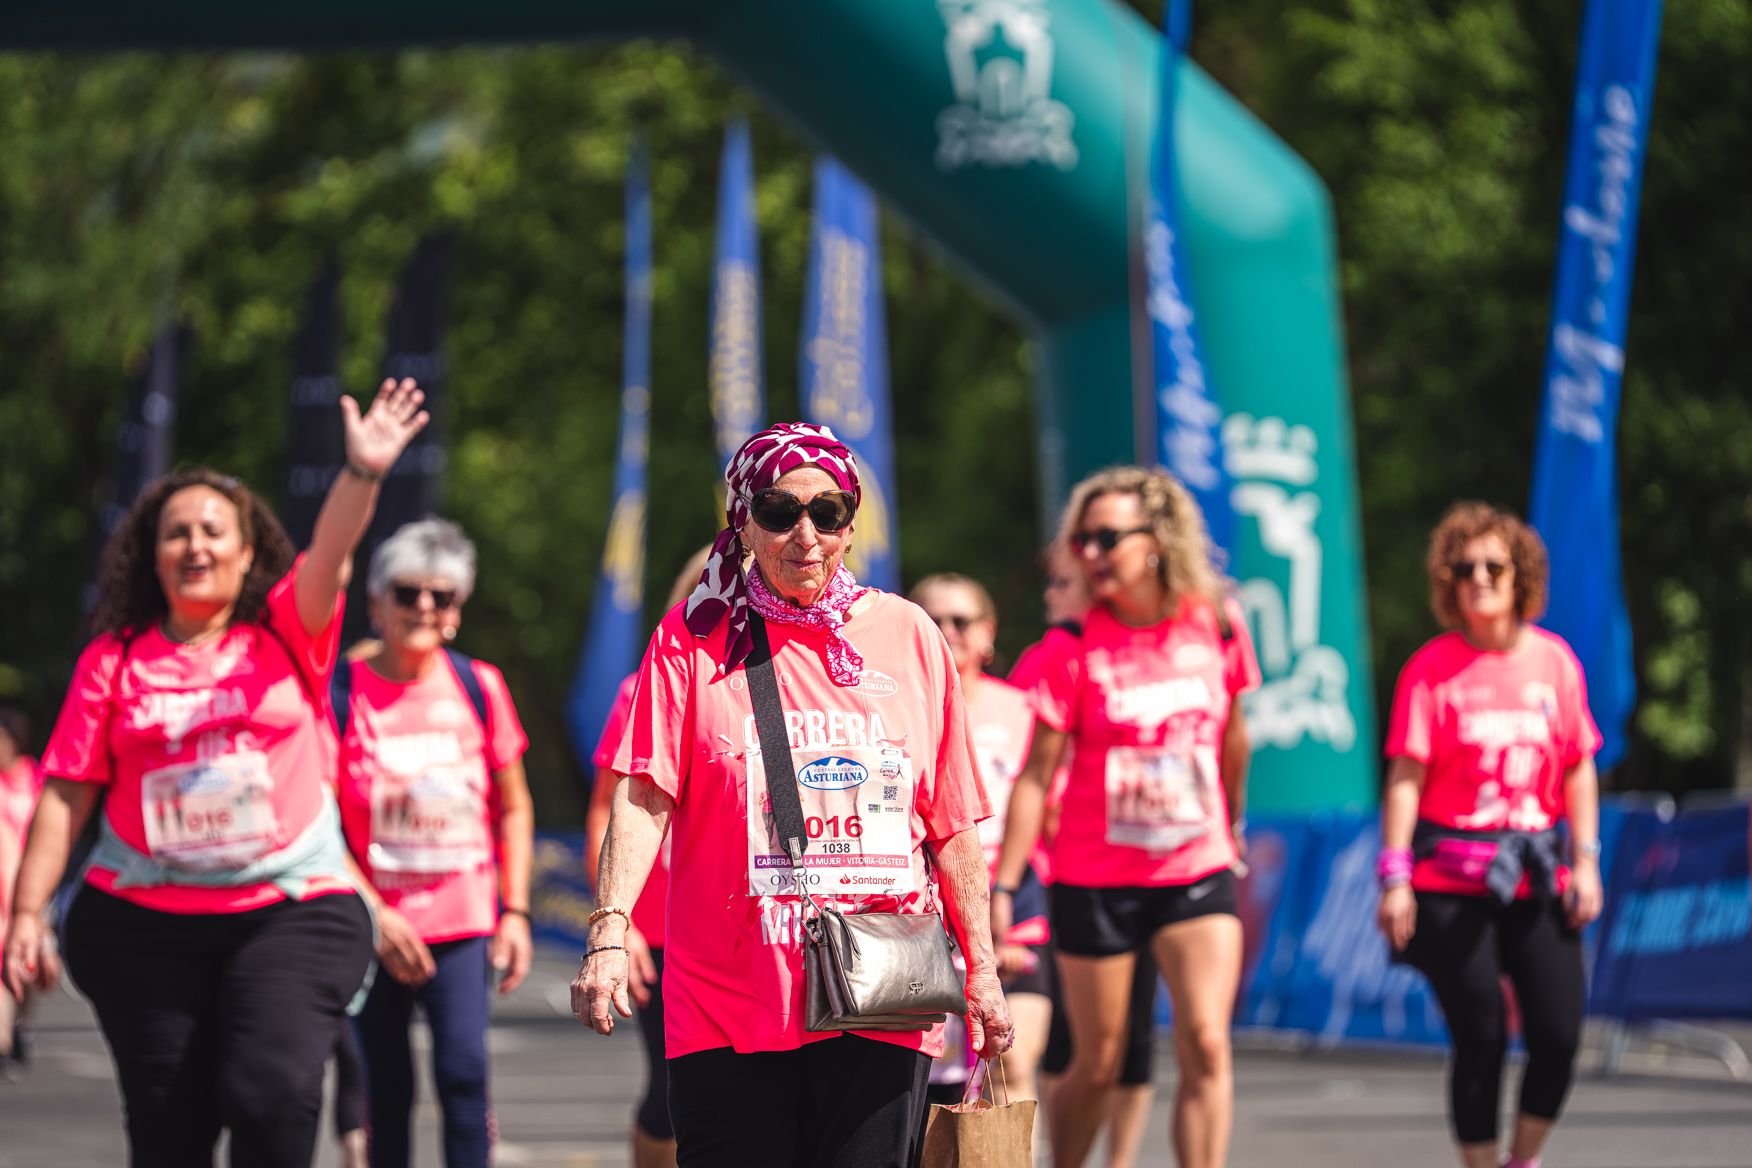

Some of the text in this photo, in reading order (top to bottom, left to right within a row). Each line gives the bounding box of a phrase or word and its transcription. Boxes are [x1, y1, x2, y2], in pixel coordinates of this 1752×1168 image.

[743, 708, 889, 749] CRRERA
[803, 769, 863, 783] ASTURIANA
[805, 815, 864, 839] 016
[822, 843, 850, 854] 1038
[757, 858, 791, 866] CARRERA
[804, 858, 815, 866] LA
[816, 857, 841, 866] MUJER
[852, 875, 896, 886] Santander
